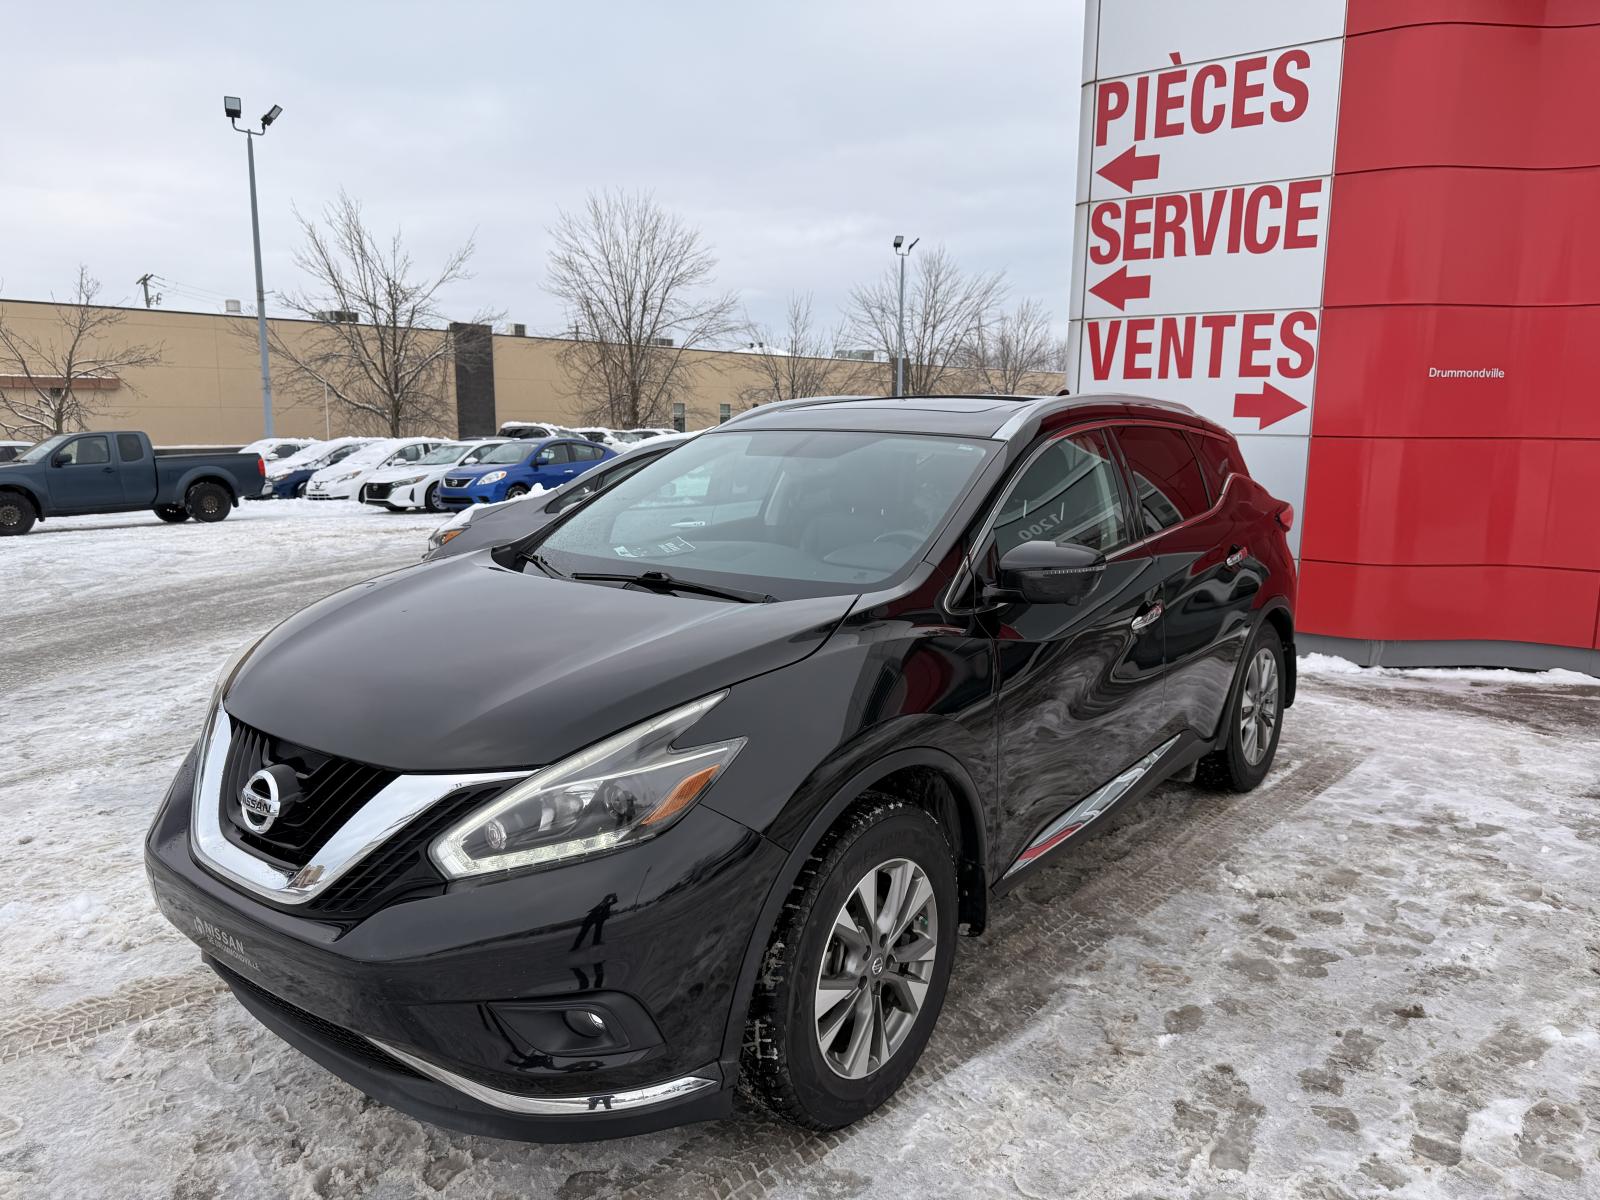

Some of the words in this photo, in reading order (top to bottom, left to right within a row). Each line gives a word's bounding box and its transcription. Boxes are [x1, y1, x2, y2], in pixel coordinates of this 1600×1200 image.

[1096, 49, 1311, 147] PIÈCES
[1089, 179, 1323, 266] SERVICE
[1087, 311, 1318, 381] VENTES
[1428, 367, 1505, 379] Drummondville
[242, 792, 272, 813] NISSAN
[203, 920, 244, 955] NISSAN
